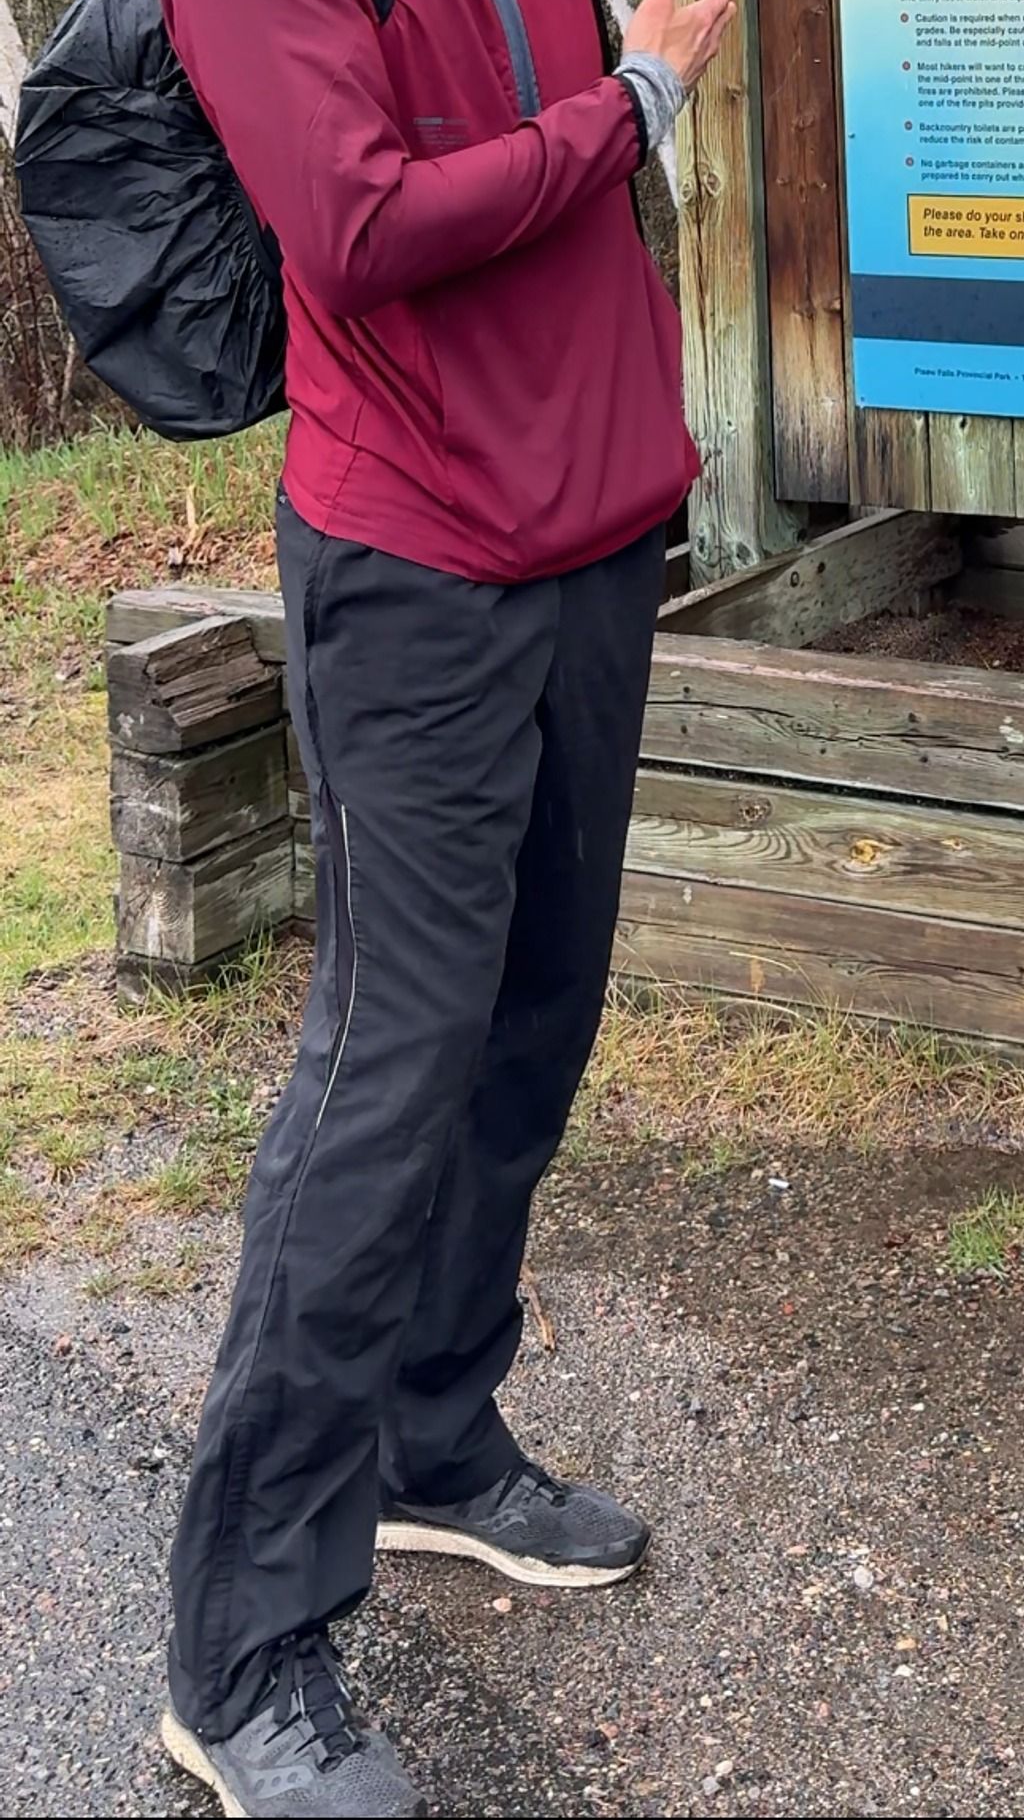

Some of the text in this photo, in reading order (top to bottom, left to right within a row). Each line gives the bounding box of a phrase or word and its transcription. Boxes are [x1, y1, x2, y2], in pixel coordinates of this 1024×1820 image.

[922, 207, 963, 221] Please
[965, 208, 982, 221] do
[984, 212, 1012, 224] your
[923, 225, 942, 237] the
[945, 227, 974, 238] area.
[978, 226, 1006, 240] Take
